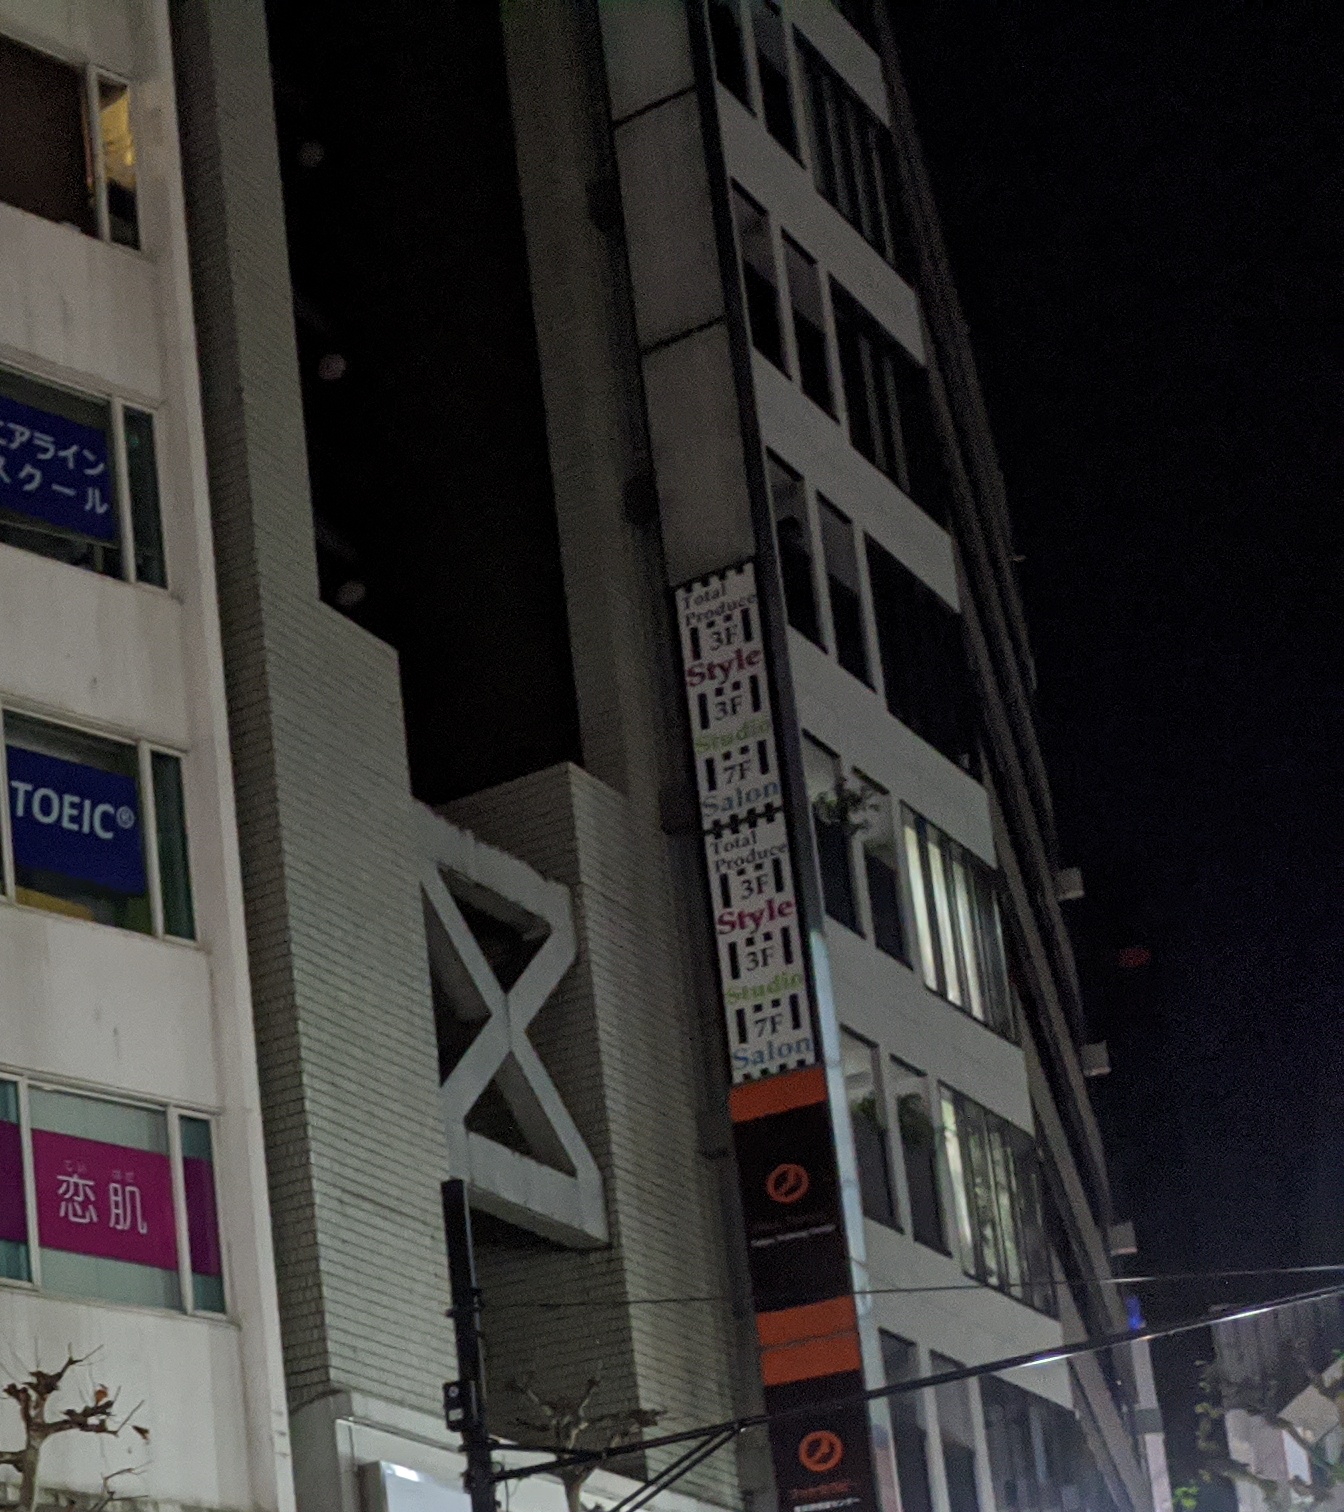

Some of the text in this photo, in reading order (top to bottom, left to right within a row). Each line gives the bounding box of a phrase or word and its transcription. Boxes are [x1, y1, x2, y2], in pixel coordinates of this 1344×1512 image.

[683, 581, 727, 611] Total
[685, 594, 758, 627] Produce
[712, 623, 738, 650] 3F
[686, 649, 763, 687] Style
[714, 696, 744, 721] 3F
[695, 716, 771, 751] Studio
[722, 758, 752, 785] 7F
[701, 781, 780, 816] Salon
[711, 830, 758, 855] Total
[715, 841, 788, 874] Produce
[740, 874, 769, 900] 3F
[717, 898, 794, 936] Style
[745, 946, 775, 972] 3F
[725, 970, 803, 1005] Studio
[754, 1014, 784, 1040] 7F
[733, 1036, 811, 1070] Salon
[56, 1173, 148, 1234] 恋肌
